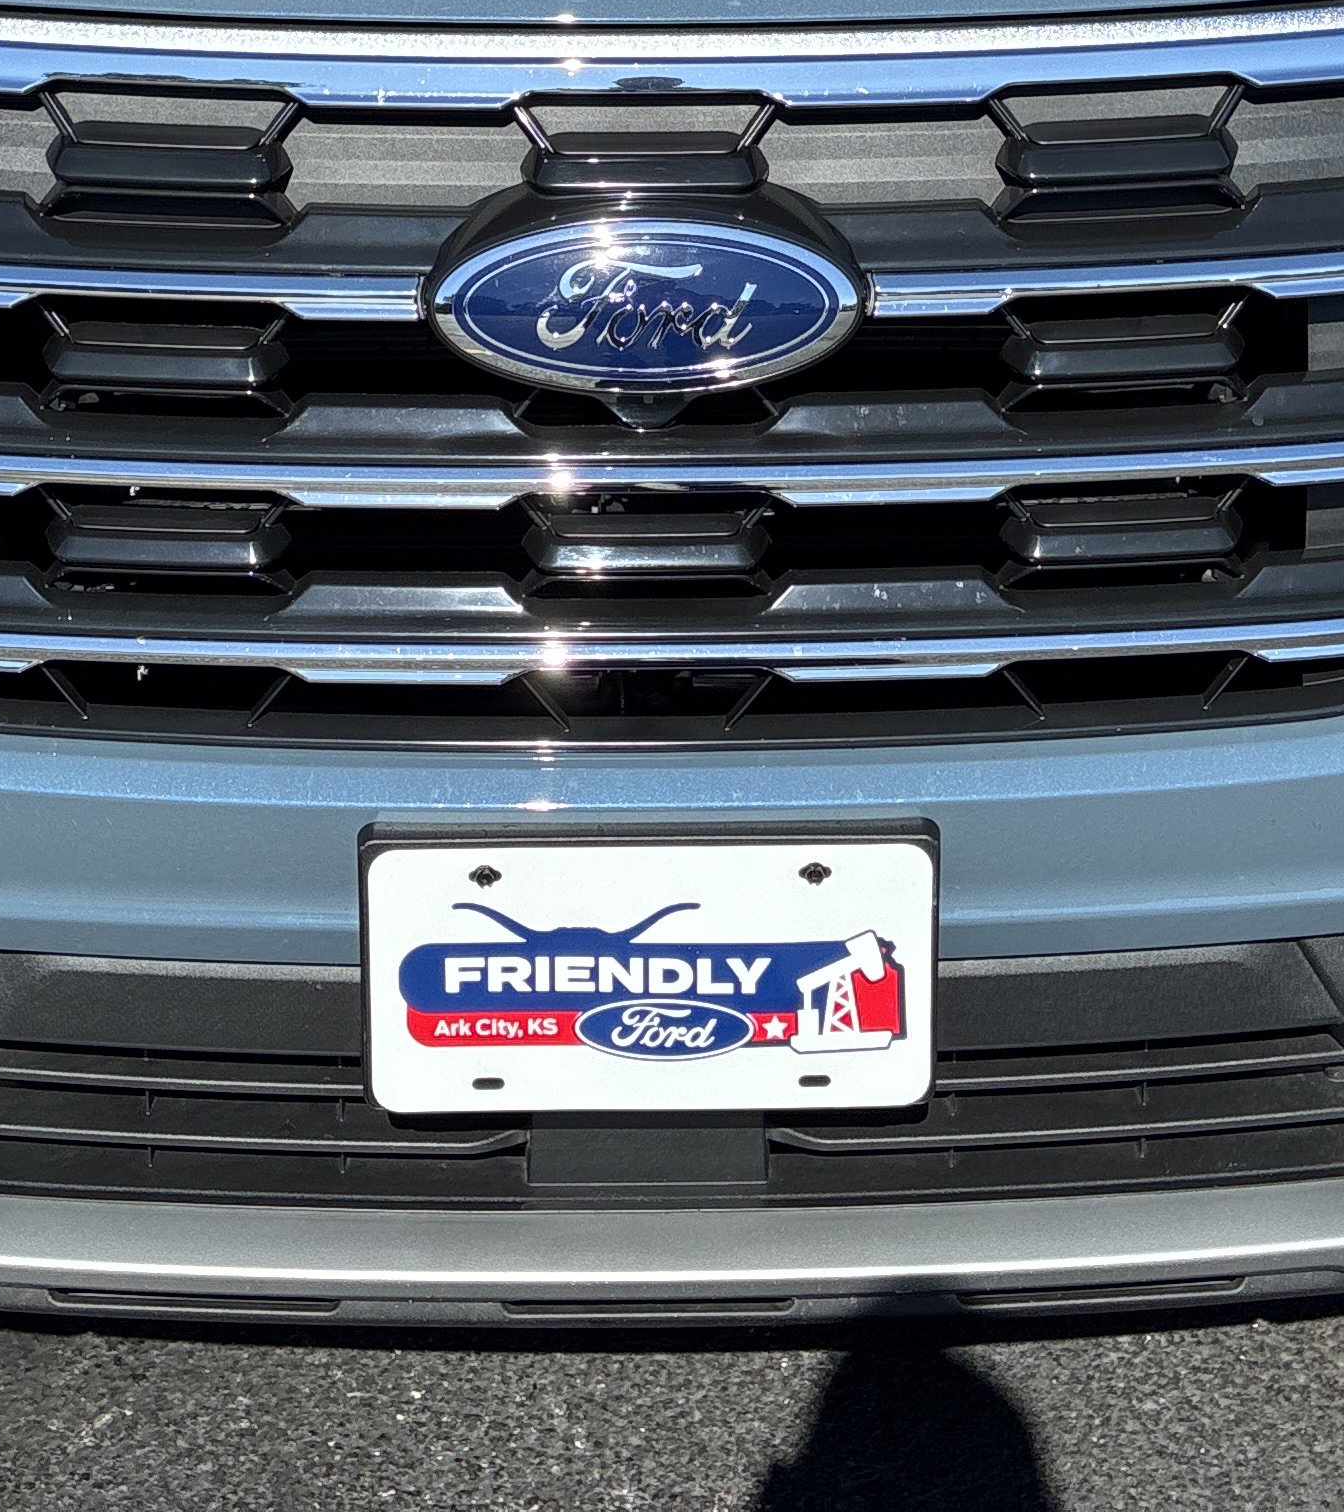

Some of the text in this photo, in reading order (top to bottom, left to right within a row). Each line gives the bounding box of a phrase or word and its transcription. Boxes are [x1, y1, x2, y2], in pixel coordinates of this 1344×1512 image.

[536, 259, 758, 350] Ford
[444, 956, 772, 994] FRIENDLY
[433, 1017, 559, 1042] Ark City, KS
[612, 1006, 716, 1048] Ford
